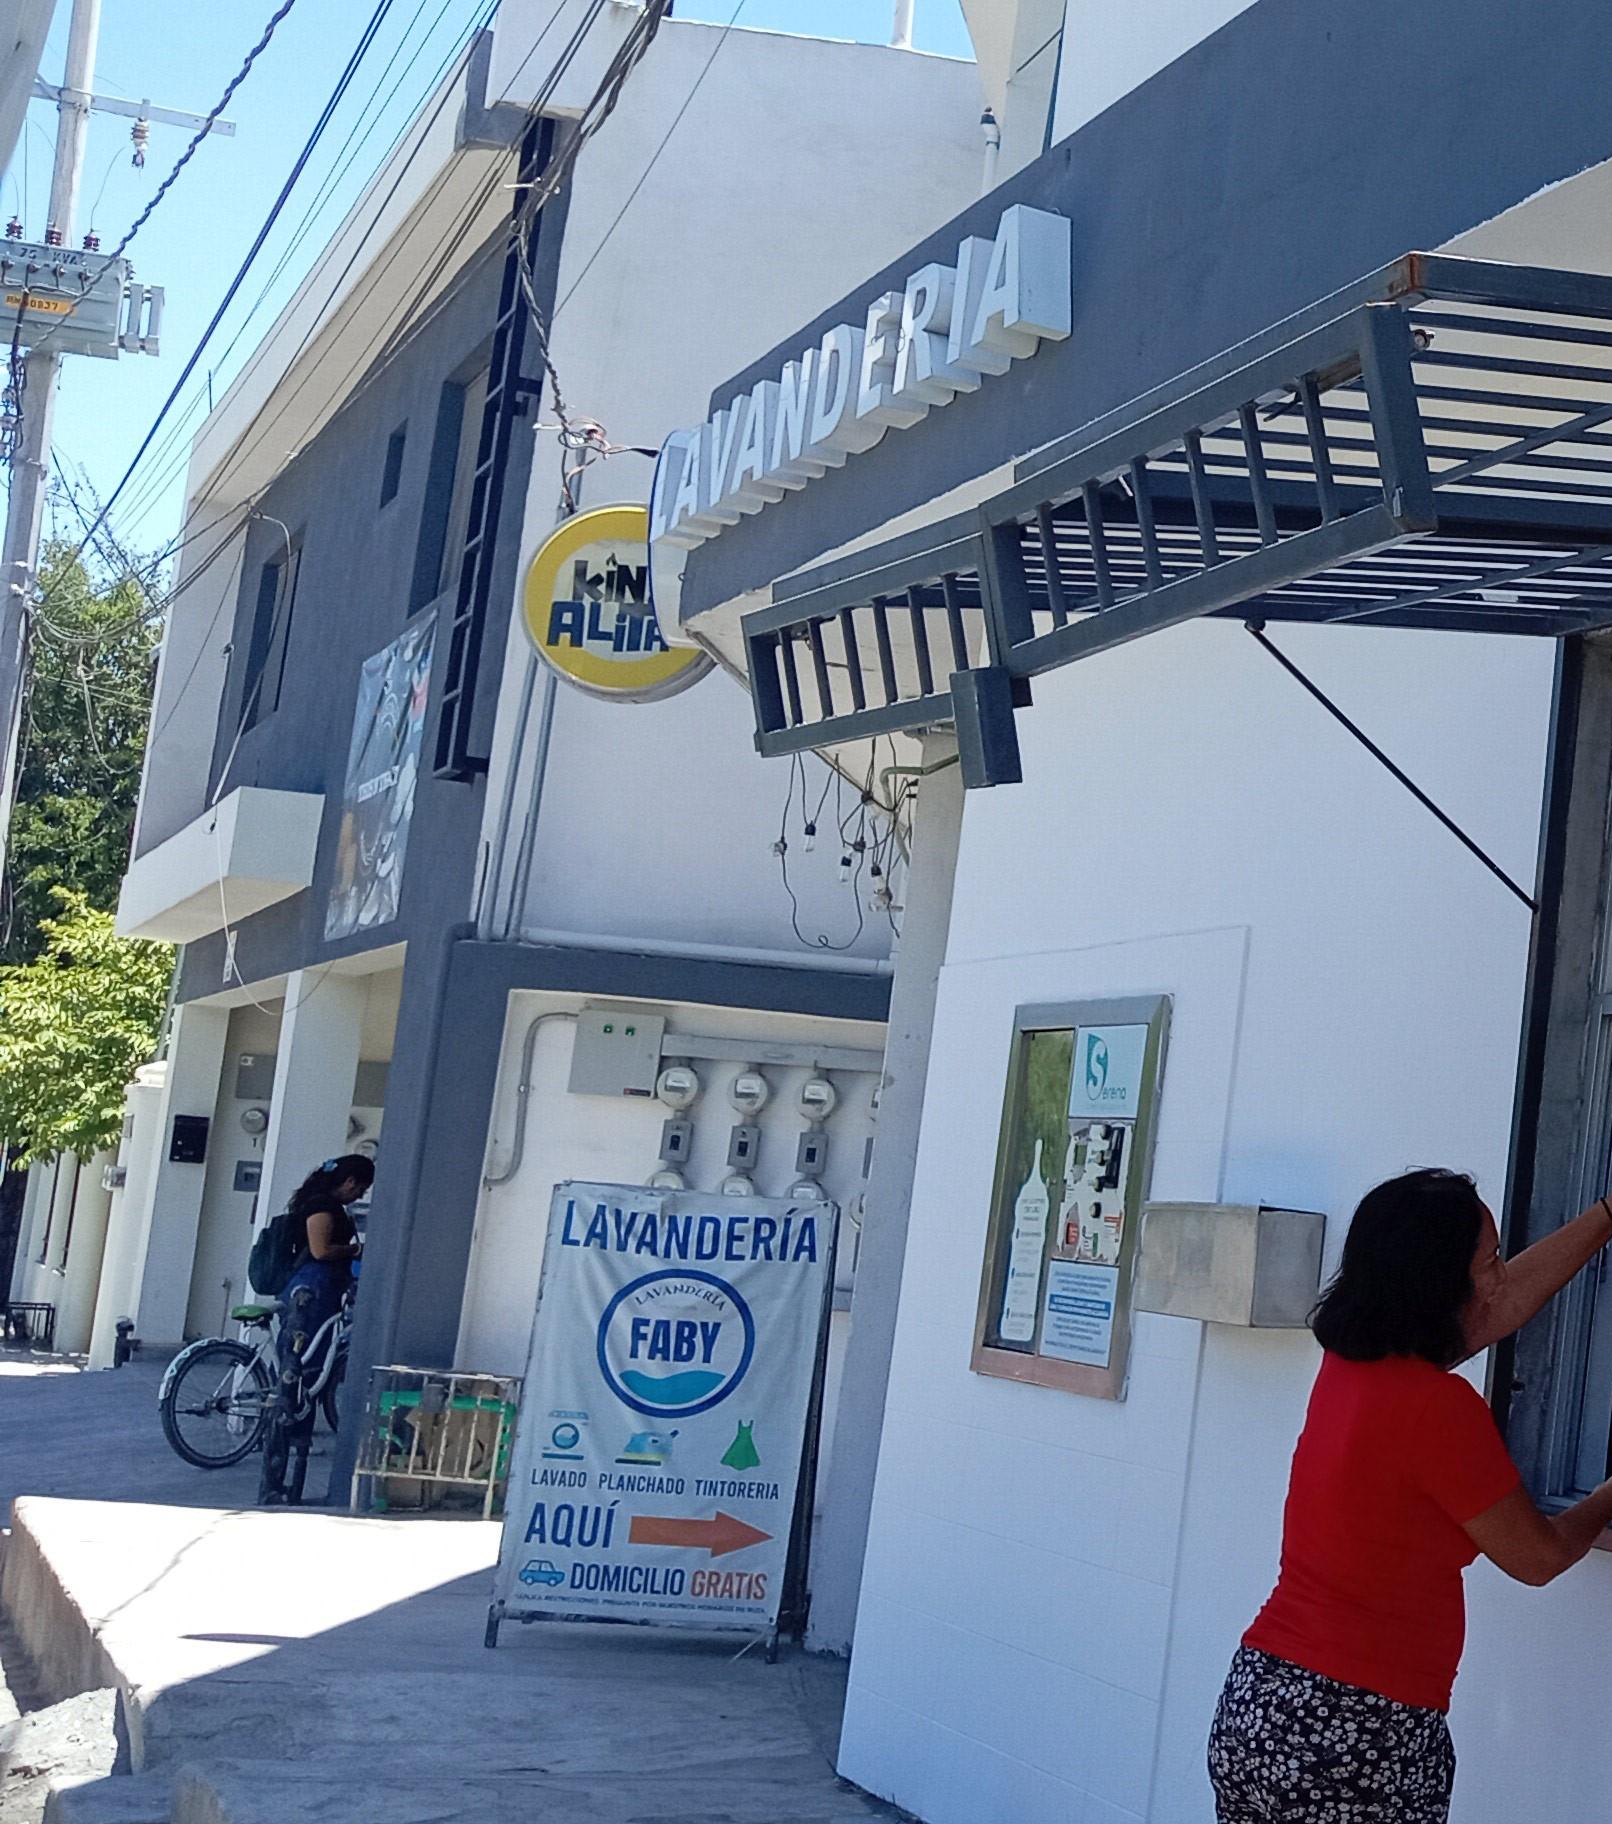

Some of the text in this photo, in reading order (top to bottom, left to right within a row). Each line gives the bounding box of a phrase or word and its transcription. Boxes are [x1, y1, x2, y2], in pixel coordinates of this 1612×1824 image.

[652, 203, 1068, 550] LAVANDERIA
[561, 1200, 818, 1263] LAVANDERÍA
[628, 1317, 722, 1365] FABY
[531, 1468, 780, 1501] LAVADO PLANCHADO TINTORERIA
[524, 1500, 621, 1549] AQUÍ
[569, 1561, 768, 1601] DOMICILIO GRATIS
